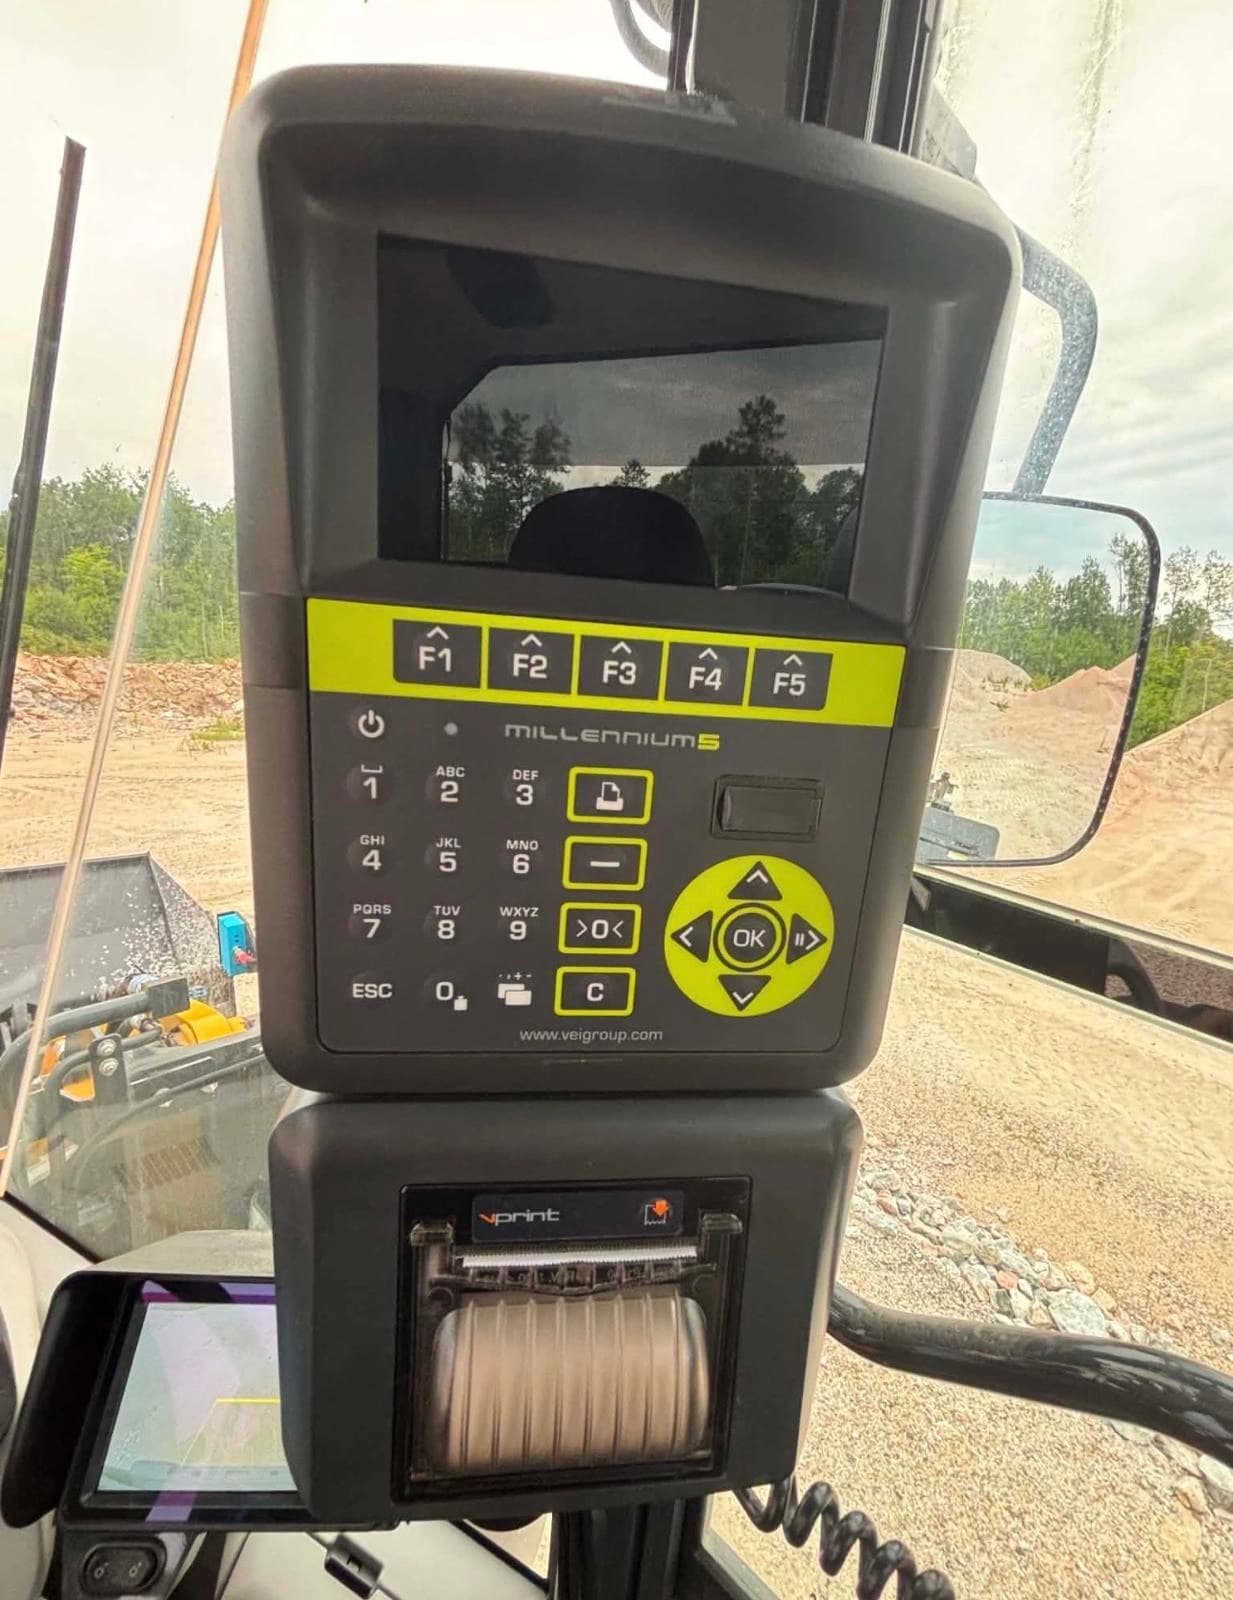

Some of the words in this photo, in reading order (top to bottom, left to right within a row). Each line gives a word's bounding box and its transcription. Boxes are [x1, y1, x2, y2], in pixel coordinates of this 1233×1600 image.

[418, 645, 453, 673] F1
[512, 652, 548, 680] F2
[601, 659, 637, 686] F3
[688, 666, 723, 691] F4
[772, 672, 807, 697] F5
[435, 765, 466, 778] ABC
[512, 769, 540, 782] DEF
[362, 776, 377, 800] 1
[440, 781, 459, 803] 2
[515, 784, 534, 806] 3
[359, 834, 385, 846] GHI
[435, 838, 461, 849] JKL
[506, 839, 539, 851] MNO
[361, 849, 382, 871] 4
[439, 852, 457, 873] 5
[512, 853, 530, 874] 6
[353, 903, 392, 916] PQRS
[433, 905, 461, 917] TUV
[500, 906, 539, 918] WXYZ
[362, 918, 382, 939] 7
[437, 919, 456, 940] 8
[509, 920, 527, 941] 9
[732, 928, 766, 948] OK
[352, 982, 393, 999] ESC
[586, 982, 604, 1002] C
[519, 1028, 664, 1044] www.veigroup.com
